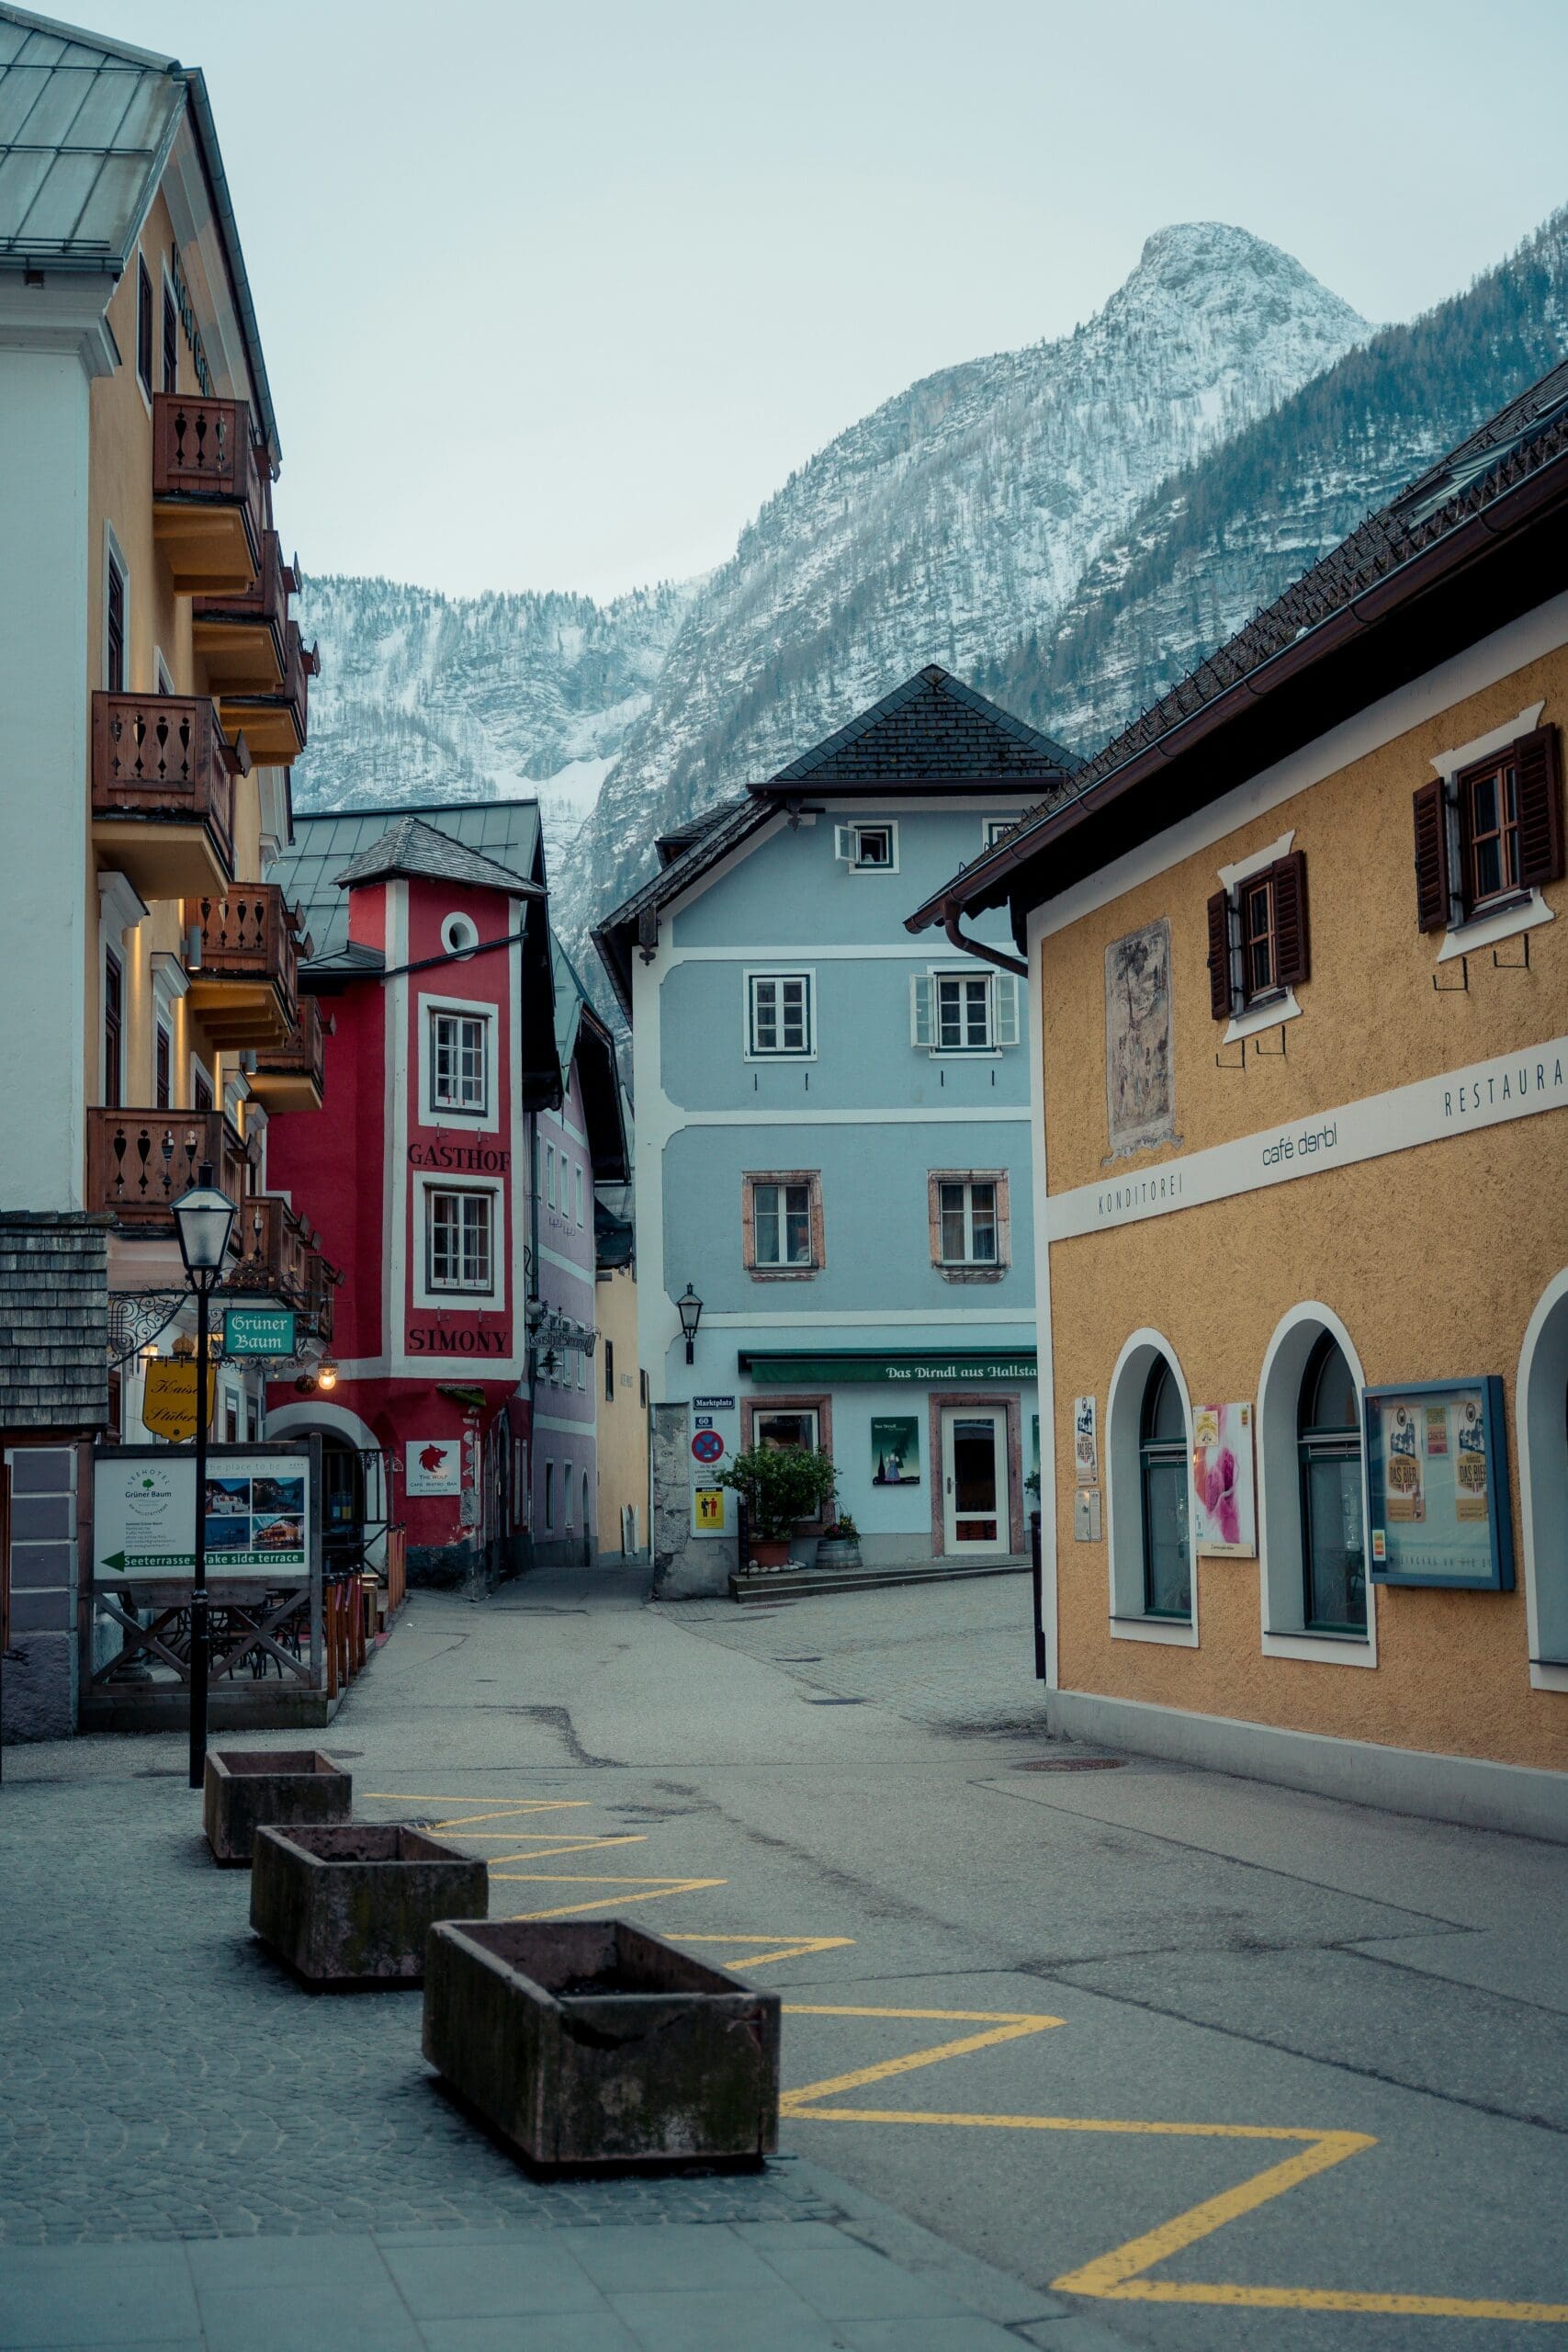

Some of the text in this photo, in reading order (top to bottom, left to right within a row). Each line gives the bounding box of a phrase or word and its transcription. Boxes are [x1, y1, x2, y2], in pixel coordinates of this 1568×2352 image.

[407, 1143, 512, 1171] GASTHOF
[1262, 1136, 1294, 1167] café
[1098, 1172, 1183, 1215] KONDITOREI
[231, 1315, 288, 1330] Grüner
[234, 1334, 282, 1349] Baum
[409, 1329, 509, 1352] SIMONY
[886, 1367, 911, 1378] Das
[915, 1366, 956, 1378] Dirndl
[961, 1368, 984, 1377] aus
[695, 1399, 732, 1408] Marktplatz
[226, 1463, 251, 1471] place
[1389, 1466, 1402, 1483] DAS
[1460, 1465, 1472, 1482] DAS
[125, 1490, 150, 1498] Grüner
[124, 1556, 190, 1566] Seeterrasse
[231, 1554, 254, 1563] side
[258, 1554, 299, 1562] terrace
